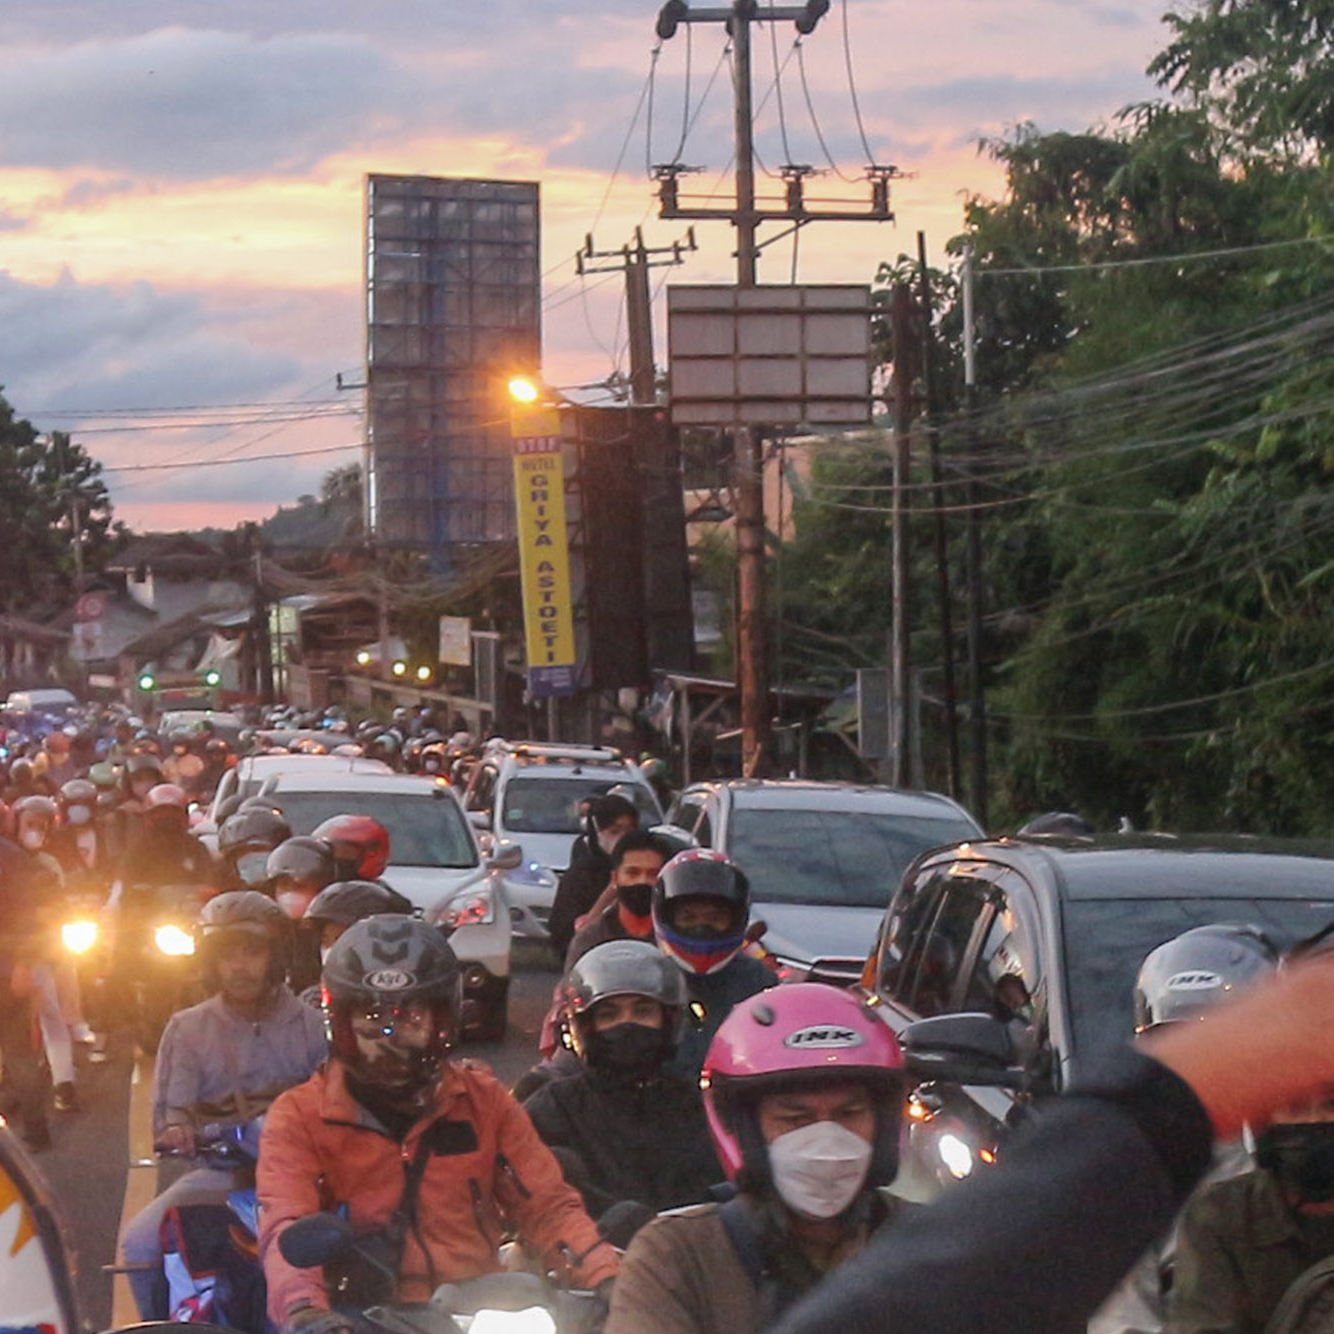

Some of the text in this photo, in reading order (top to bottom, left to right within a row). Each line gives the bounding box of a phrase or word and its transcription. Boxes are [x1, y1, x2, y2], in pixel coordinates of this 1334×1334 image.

[530, 474, 553, 547] GRIYA
[536, 560, 559, 662] ASTOETI
[792, 1030, 855, 1044] INK
